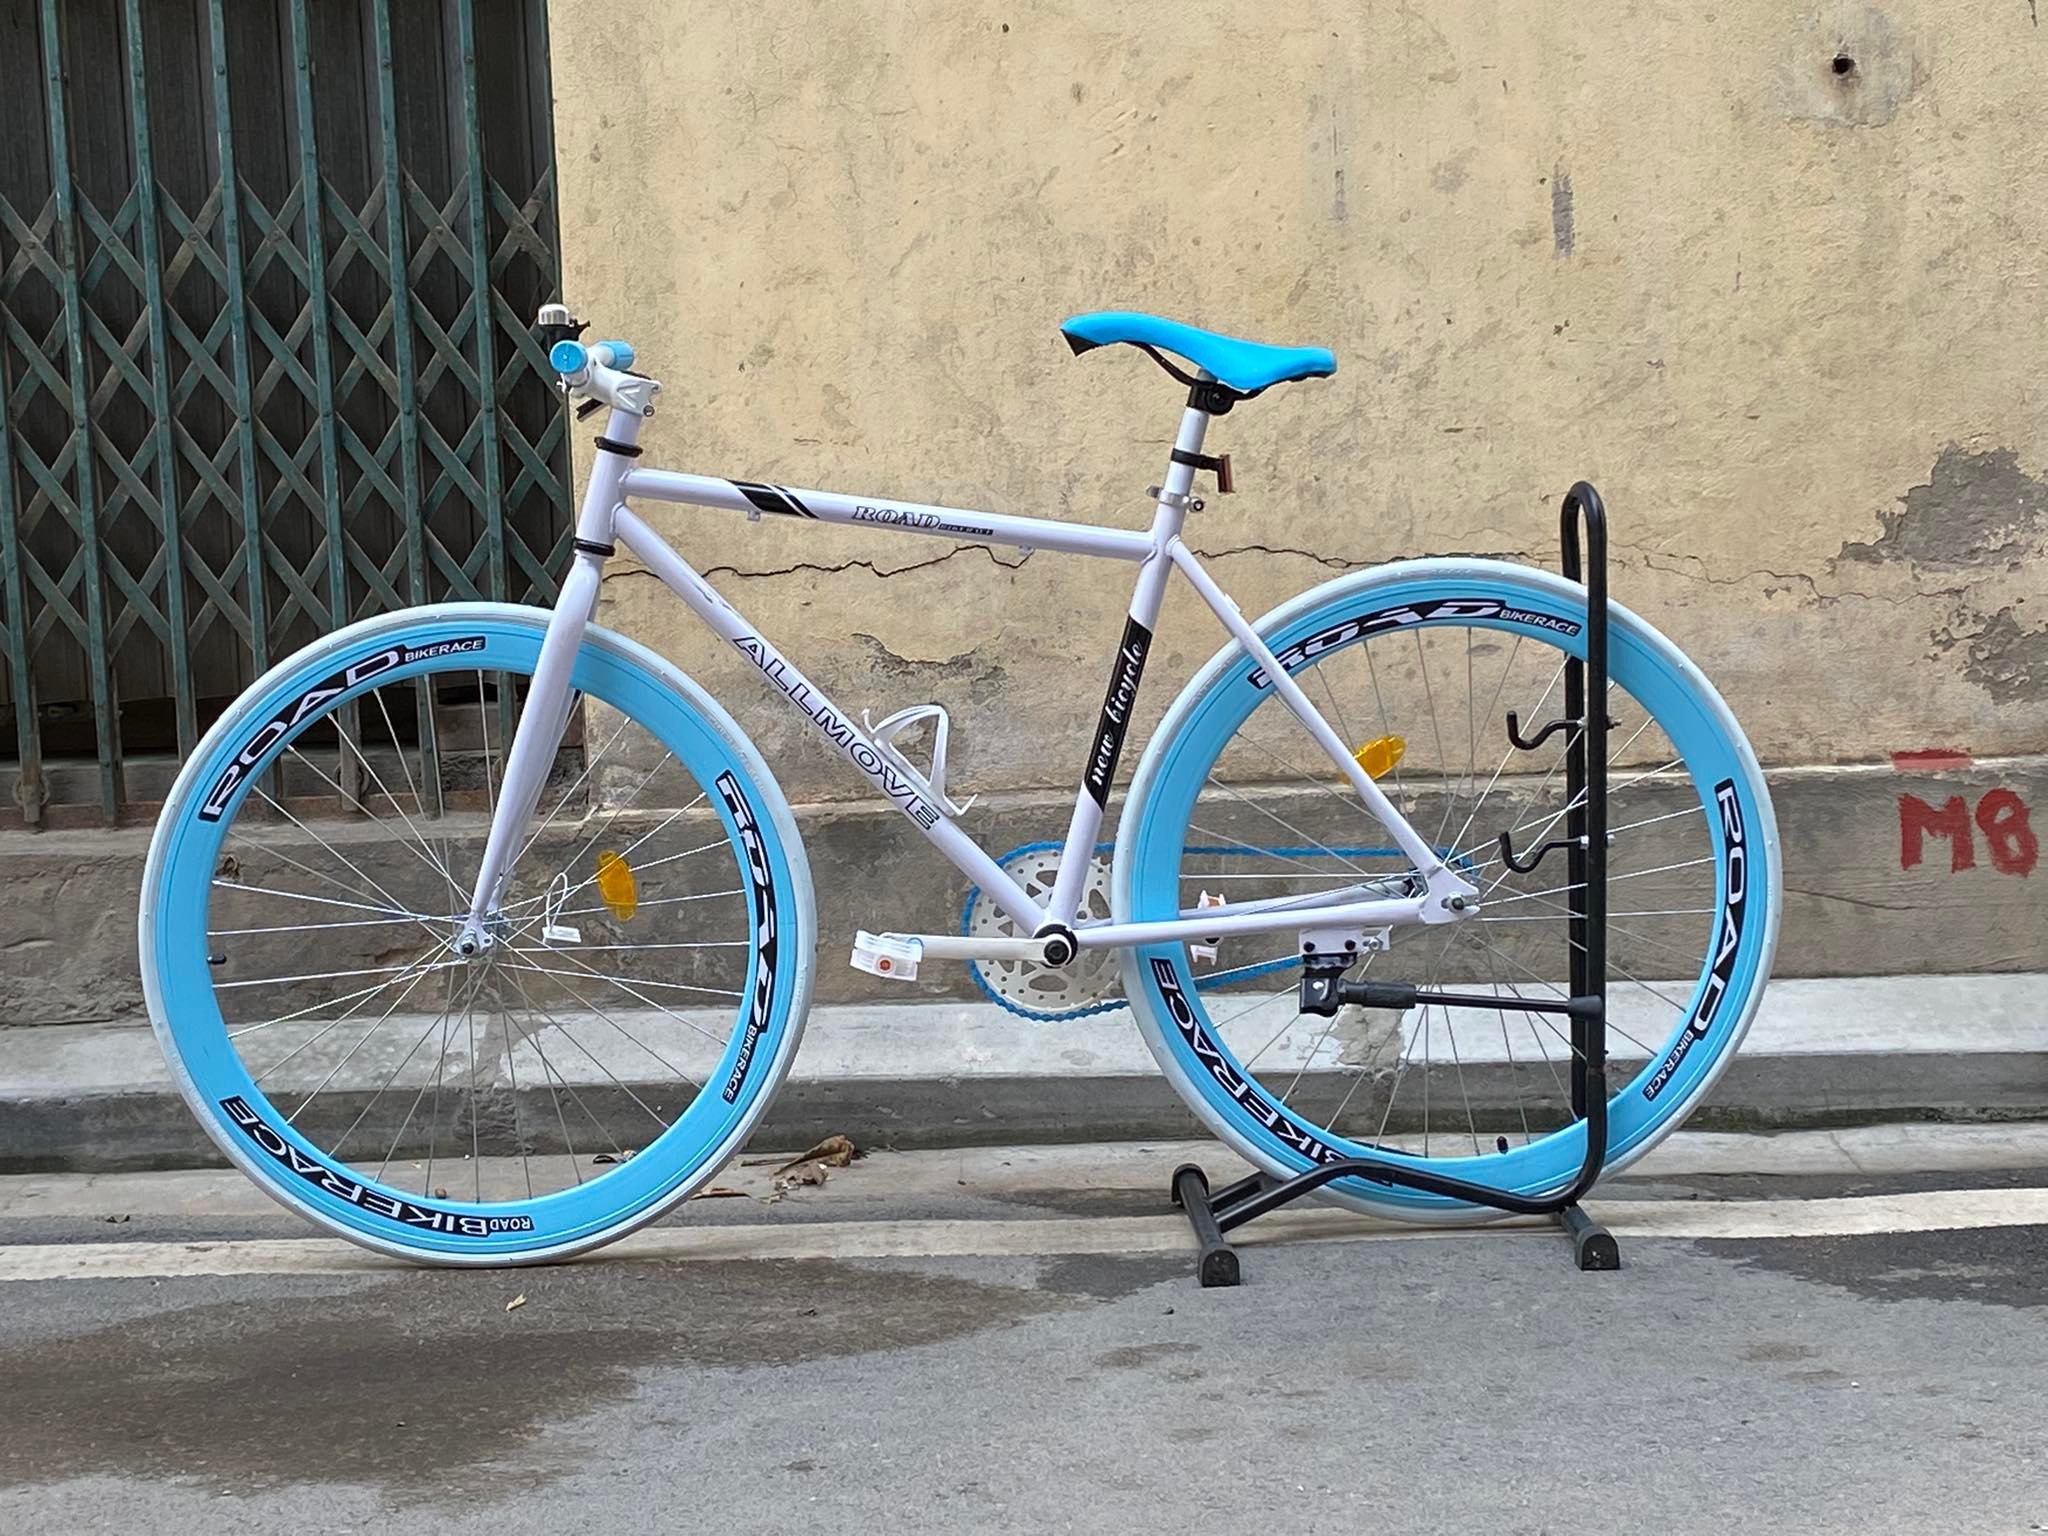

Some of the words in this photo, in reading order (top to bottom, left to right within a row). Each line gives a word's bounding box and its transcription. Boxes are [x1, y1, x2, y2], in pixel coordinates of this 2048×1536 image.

[852, 506, 940, 530] ROAD
[1253, 601, 1501, 688] ROAD
[1500, 609, 1580, 636] BIKERACE
[202, 649, 400, 816] ROAD
[404, 638, 485, 663] BIKERACE
[733, 636, 940, 831] ALLMOVE
[1091, 732, 1115, 786] new
[1105, 640, 1144, 724] bicycle
[1898, 787, 2039, 878] M8
[716, 773, 773, 1026] ROAD
[1694, 786, 1745, 1031] ROAD
[725, 1025, 758, 1101] BIKERACE
[1646, 1029, 1695, 1099] BIKERACE
[224, 1098, 489, 1236] BIKERACE
[490, 1216, 531, 1231] ROAD
